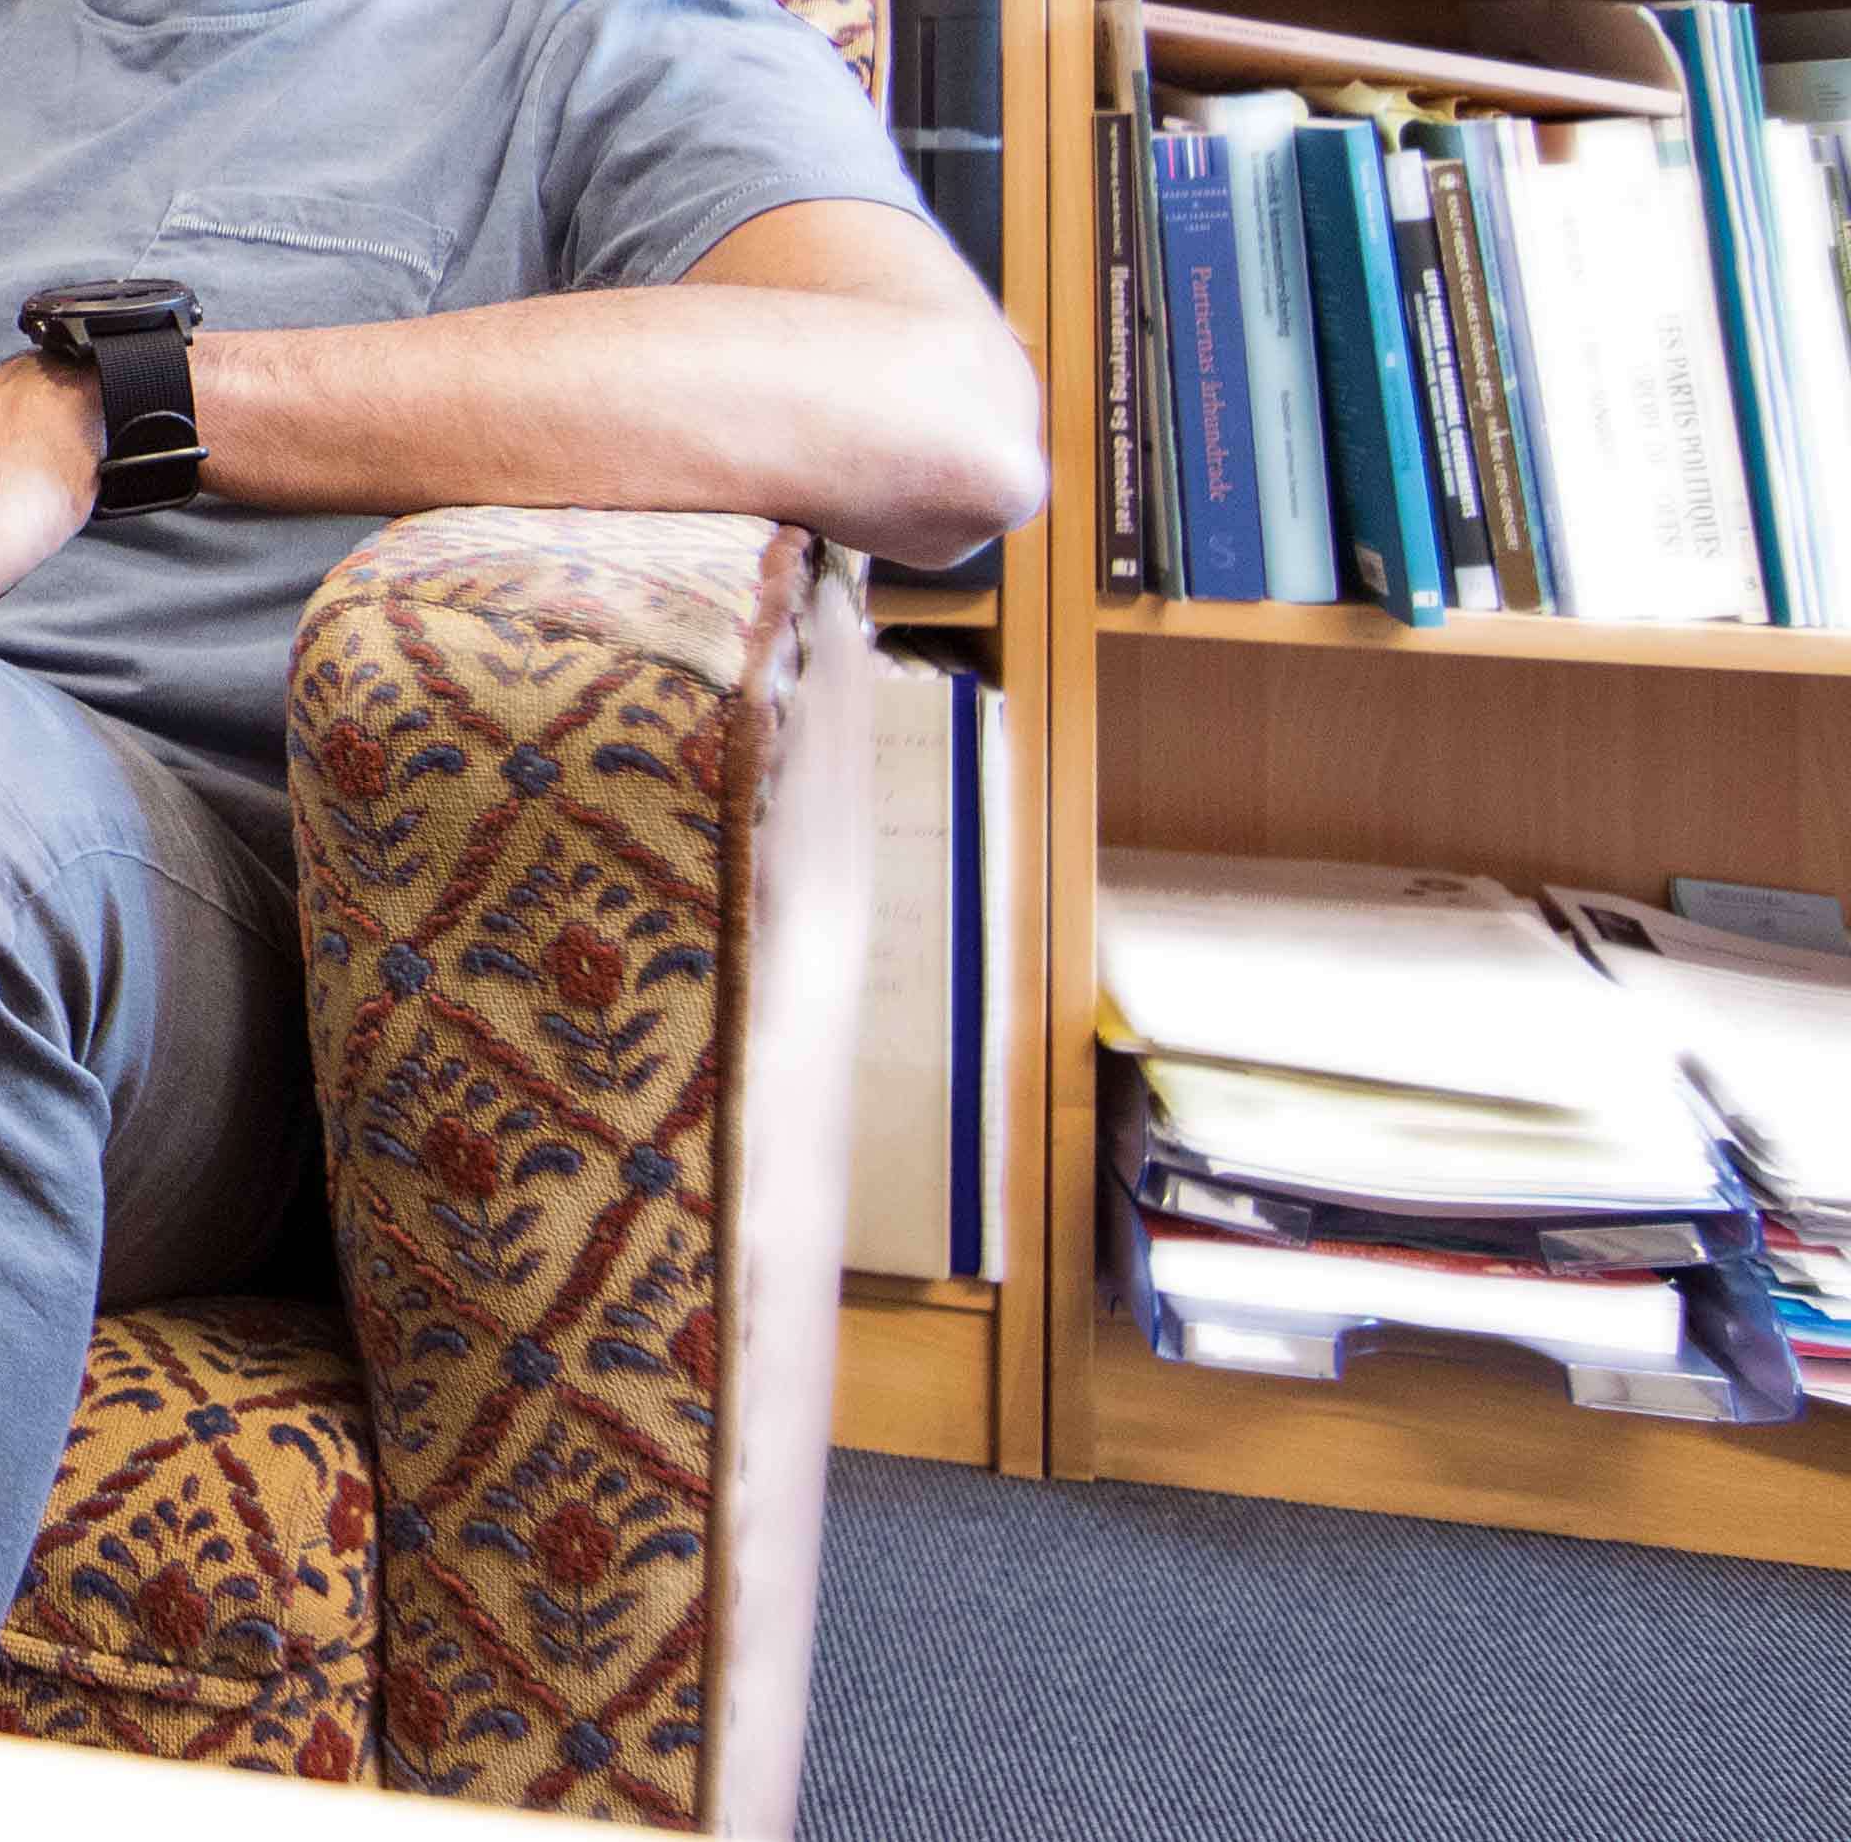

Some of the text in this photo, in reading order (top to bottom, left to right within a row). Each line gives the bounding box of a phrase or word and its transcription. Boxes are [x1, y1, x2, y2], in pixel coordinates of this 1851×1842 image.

[1111, 405, 1131, 430] og
[1190, 265, 1231, 503] Partiernas århundrade
[1665, 356, 1724, 560] PARTIS POLITIQUES
[1113, 434, 1135, 534] demokrati
